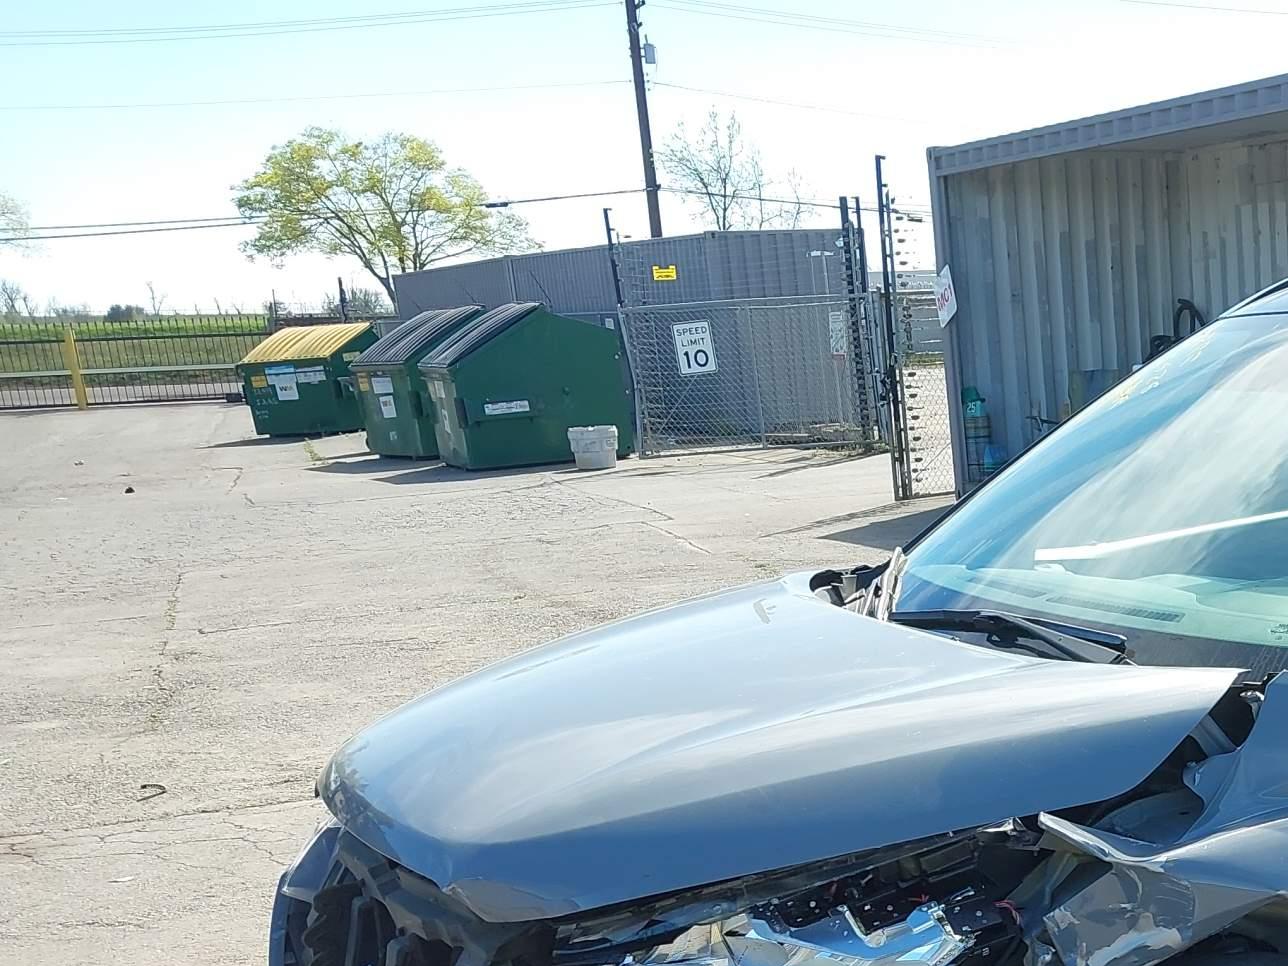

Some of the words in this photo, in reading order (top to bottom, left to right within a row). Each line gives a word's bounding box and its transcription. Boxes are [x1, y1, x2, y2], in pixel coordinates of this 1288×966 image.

[676, 326, 707, 337] SPEED
[681, 338, 705, 347] LIMIT
[683, 349, 709, 369] 10
